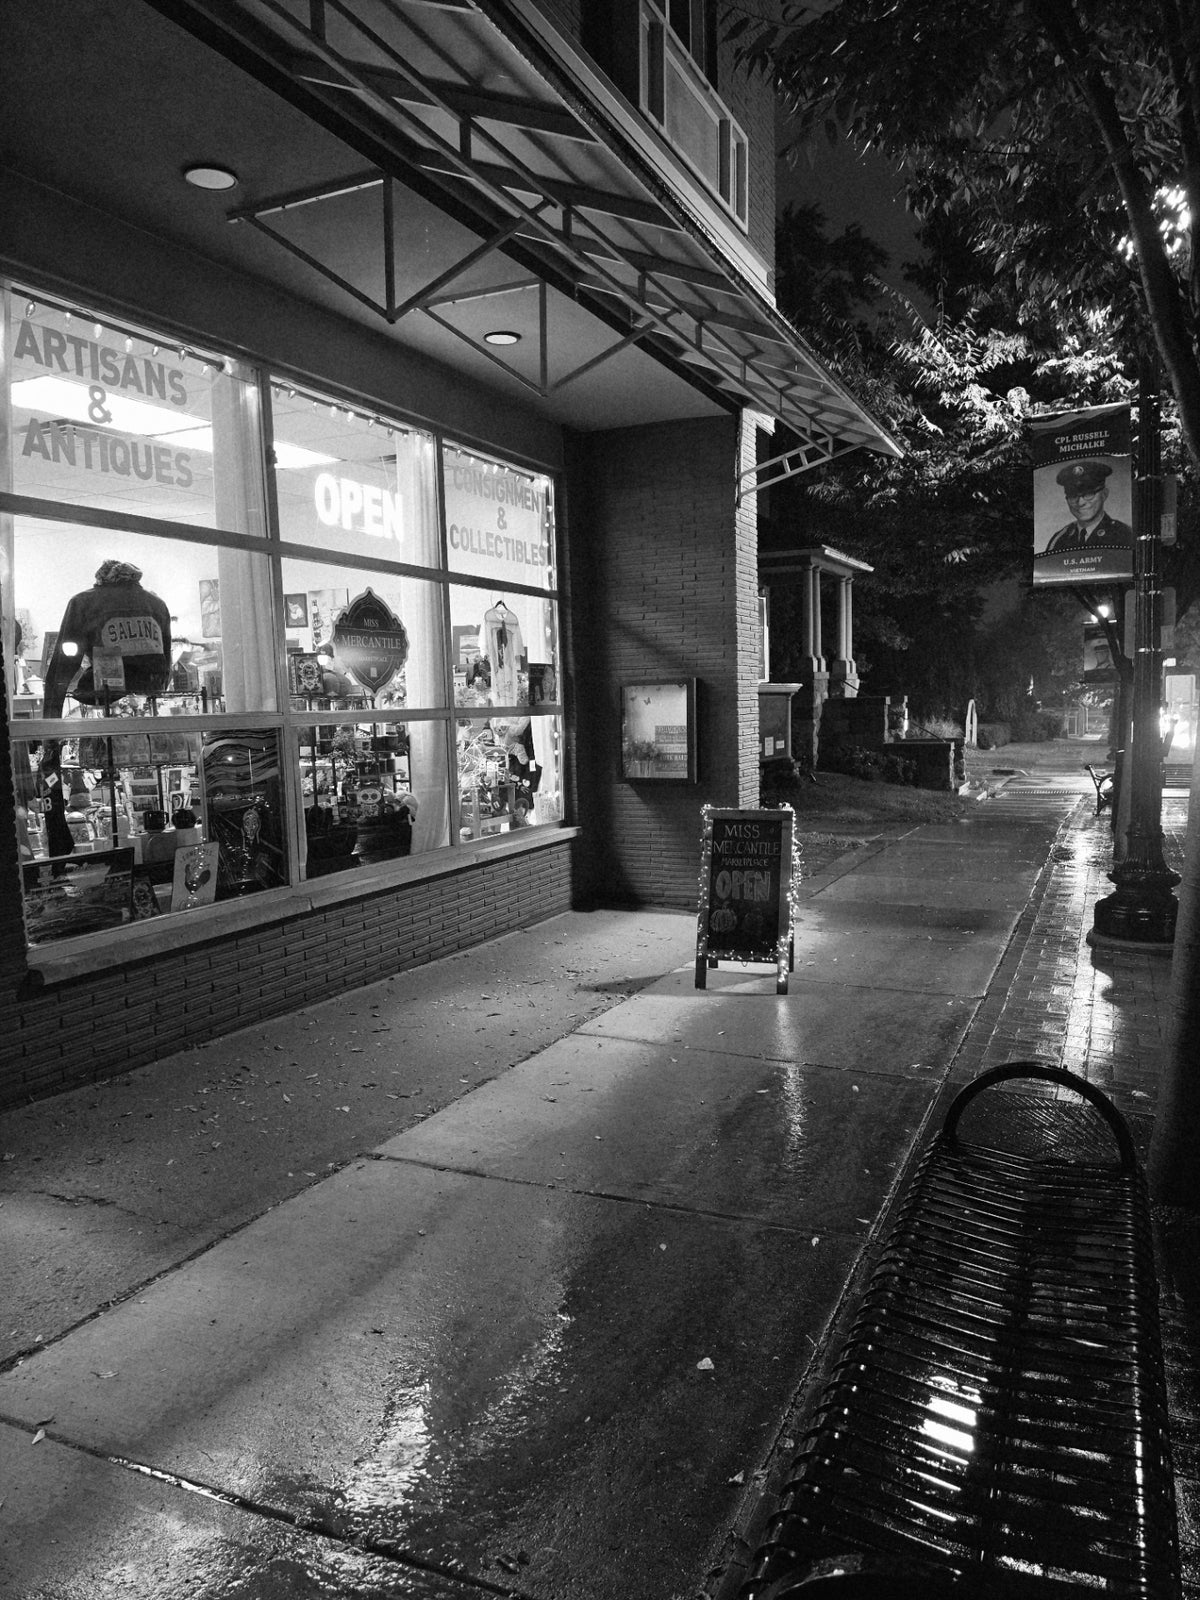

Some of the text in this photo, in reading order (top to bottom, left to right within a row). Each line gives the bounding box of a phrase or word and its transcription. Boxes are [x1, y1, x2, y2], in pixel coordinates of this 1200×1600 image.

[14, 319, 187, 406] ARTISANS
[88, 385, 113, 424] &
[1055, 430, 1110, 445] CPL RUSSELL
[1059, 439, 1105, 453] MICHALKE
[22, 417, 193, 488] ANTIQUES
[453, 465, 547, 515] CONSIGNMENT
[314, 473, 404, 544] OPEN
[497, 506, 508, 530] &
[449, 523, 547, 567] COLLECTIBLES
[1063, 555, 1103, 566] U.S. ARMY
[108, 620, 159, 642] SALINE
[363, 618, 378, 628] MISS
[341, 635, 402, 649] MERCANTILE
[724, 824, 761, 839] MISS
[715, 870, 771, 901] OPEN
